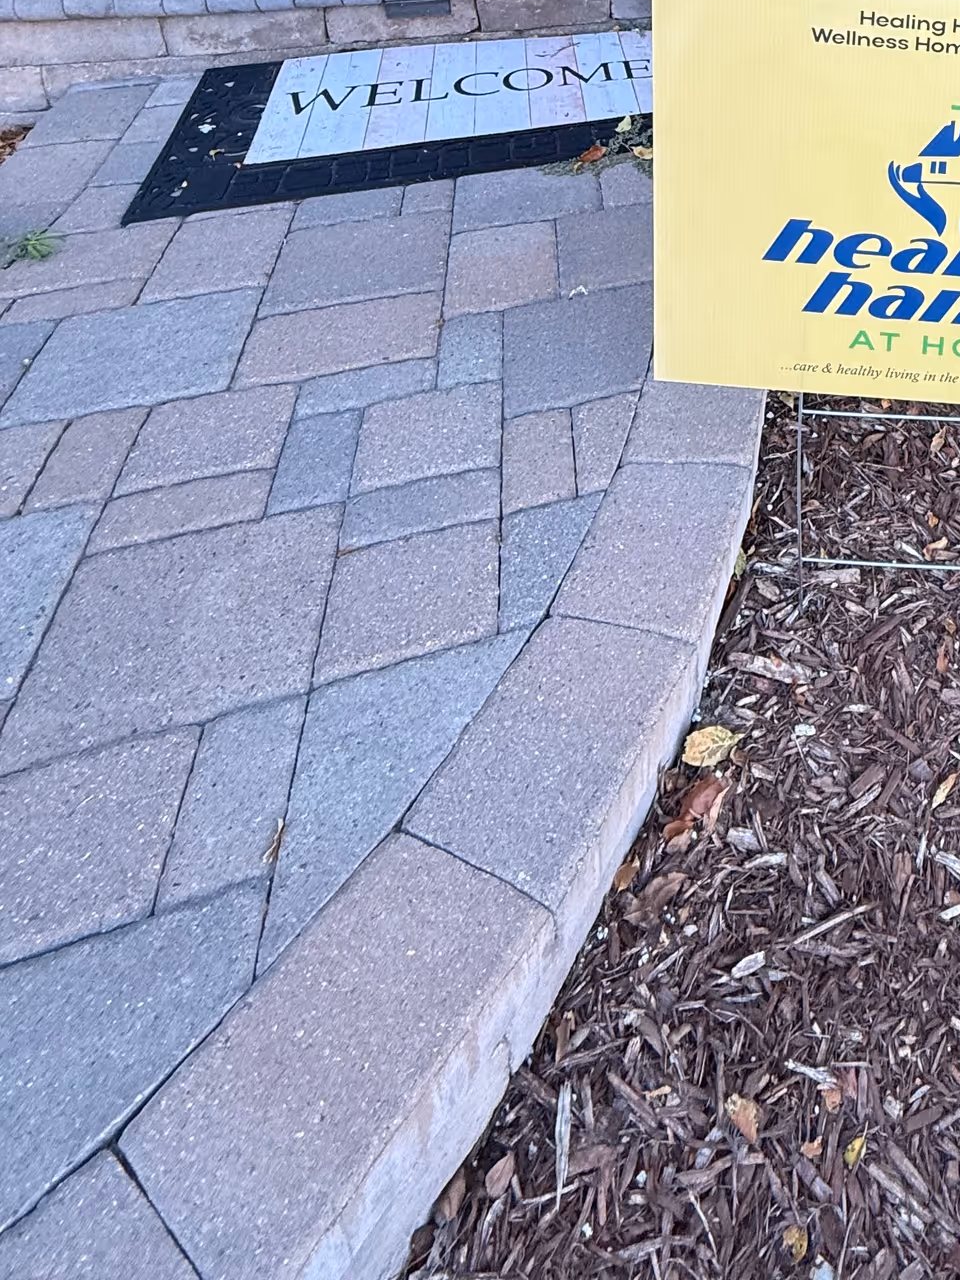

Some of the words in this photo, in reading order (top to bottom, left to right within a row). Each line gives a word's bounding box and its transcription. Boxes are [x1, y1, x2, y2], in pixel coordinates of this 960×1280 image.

[860, 10, 946, 37] Healing
[811, 27, 909, 50] Wellness
[286, 59, 653, 116] WELCOME
[848, 329, 901, 352] AT
[821, 362, 833, 374] &
[836, 363, 882, 380] healthy
[885, 367, 920, 383] living
[923, 370, 936, 383] in
[939, 372, 960, 384] the
